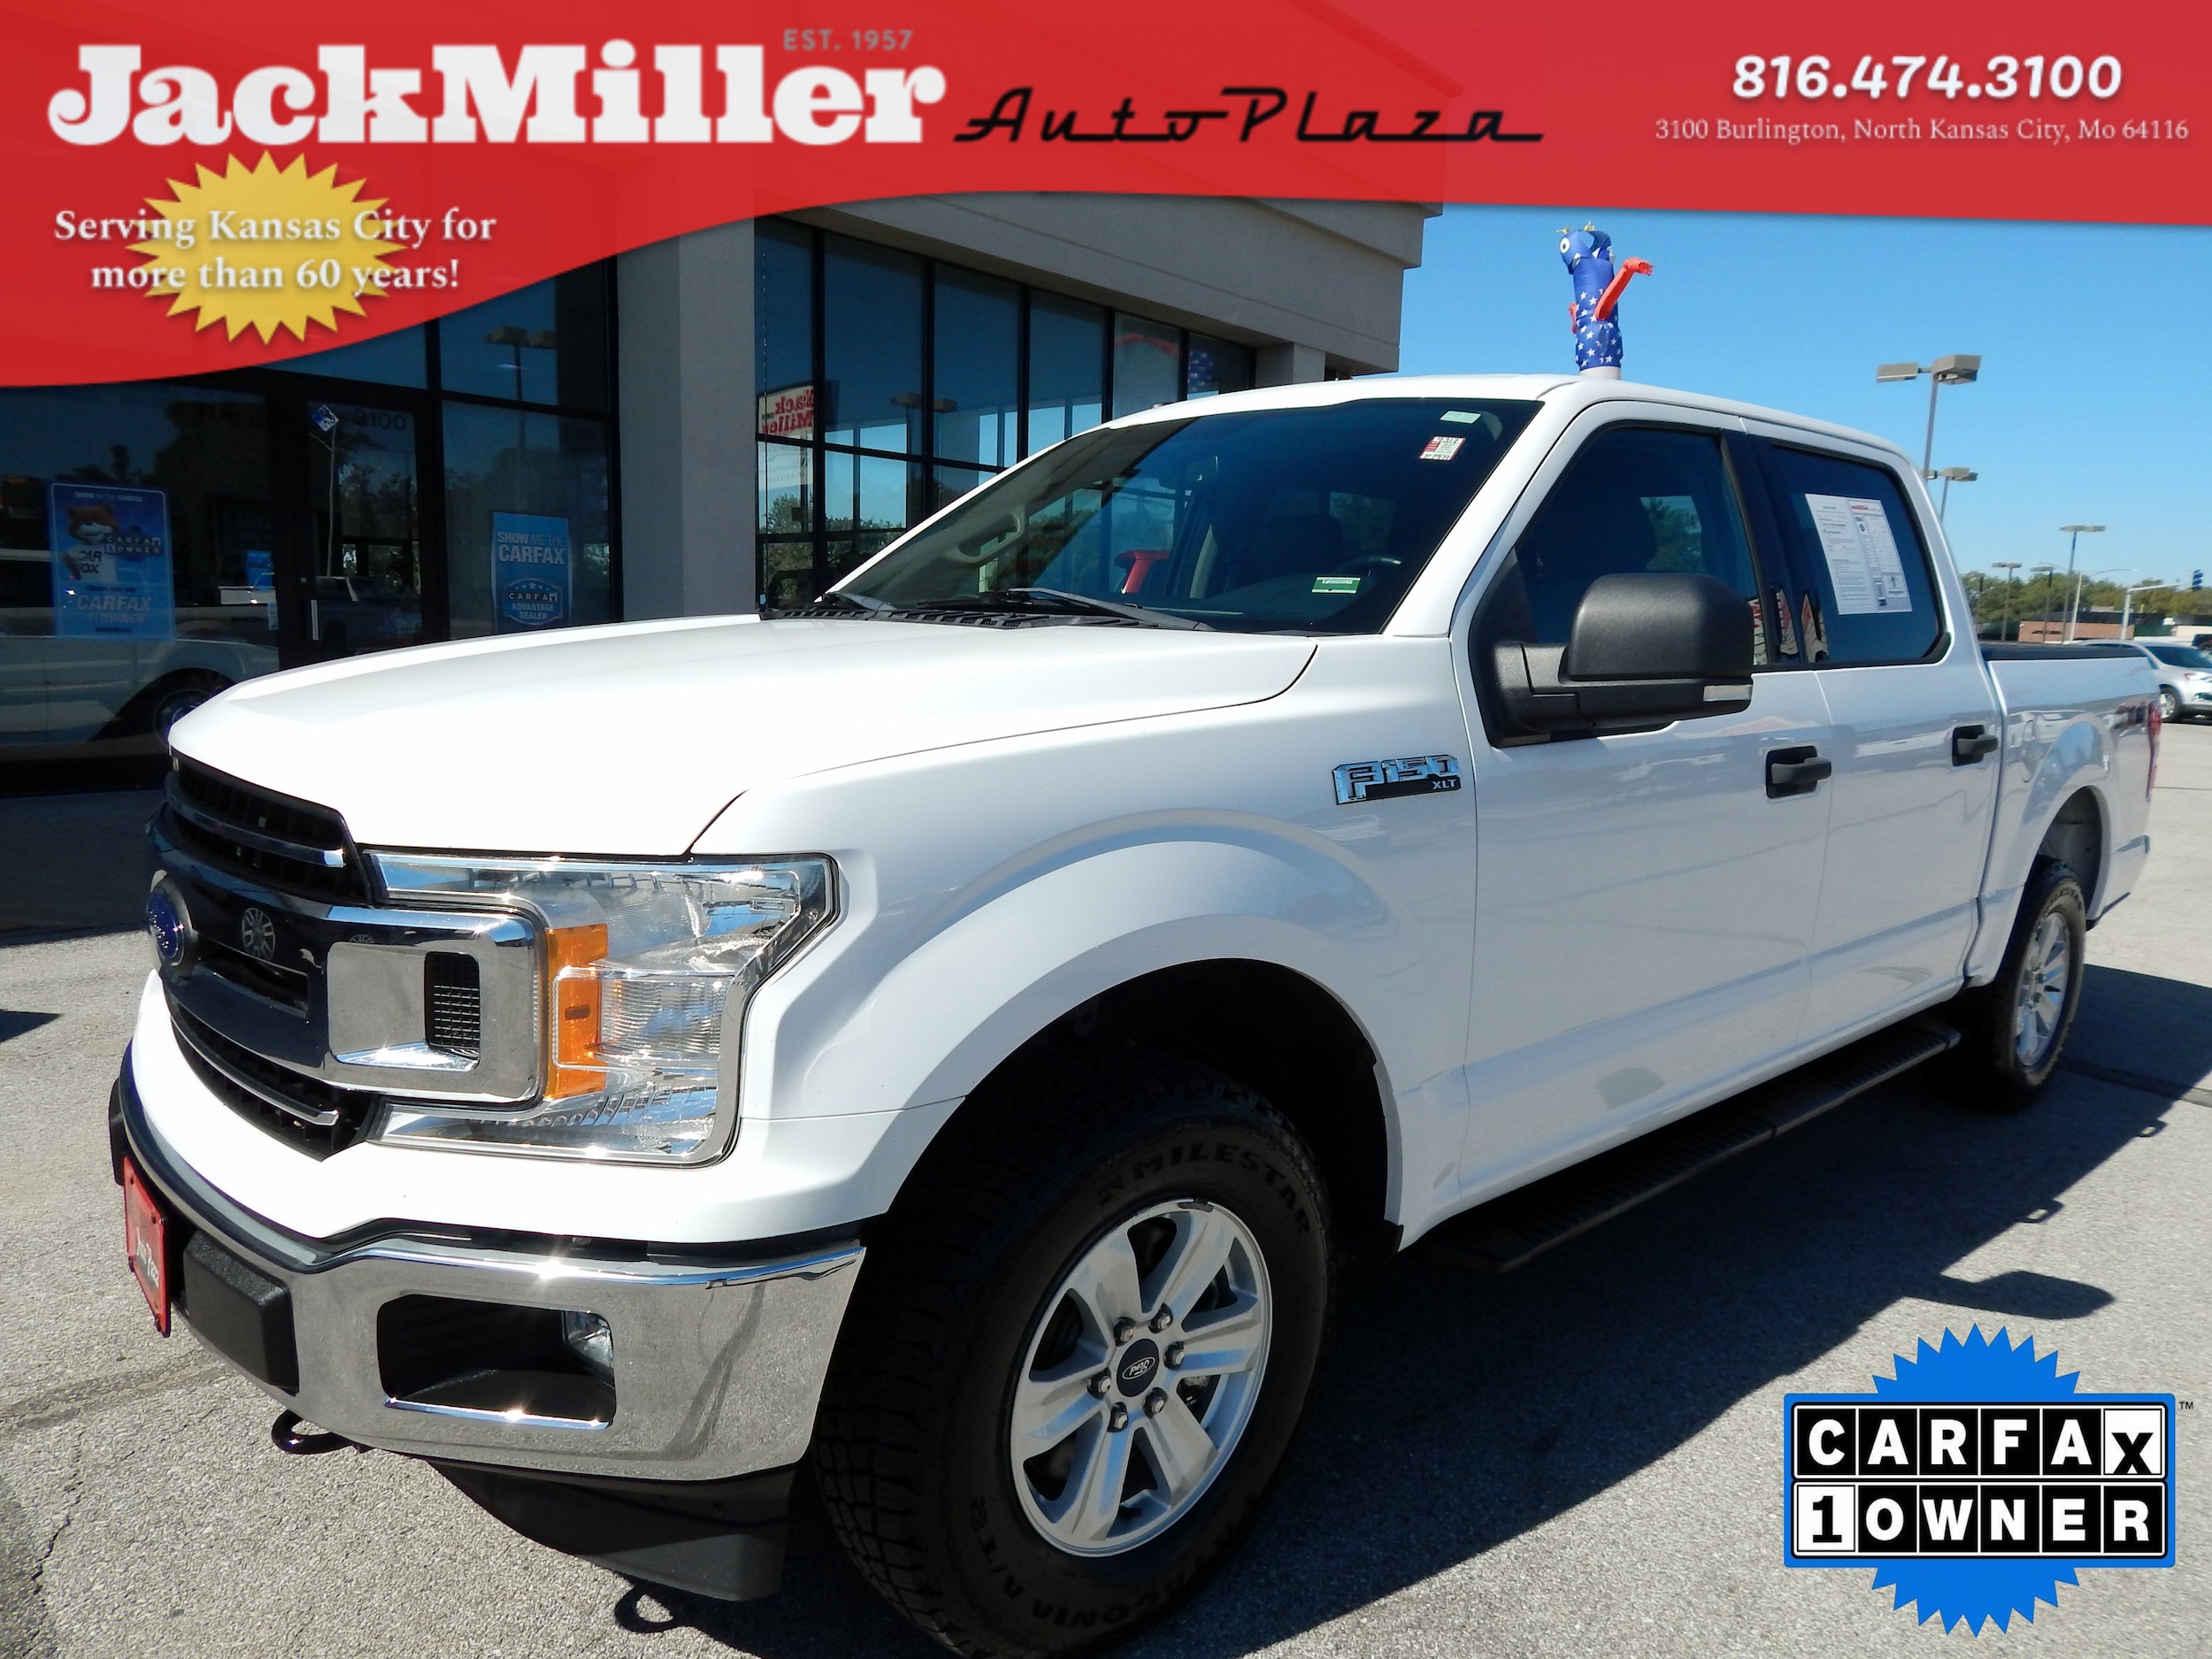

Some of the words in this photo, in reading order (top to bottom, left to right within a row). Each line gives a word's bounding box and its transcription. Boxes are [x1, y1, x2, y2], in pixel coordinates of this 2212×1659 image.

[498, 532, 529, 544] SHOW
[498, 544, 565, 565] CARFAX
[509, 591, 558, 602] CARFAX
[78, 595, 151, 611] CARFAX
[511, 603, 555, 611] ADVANTAGE
[519, 611, 548, 619] DEALER
[1432, 779, 1457, 790] XLT
[1133, 1142, 1310, 1233] MILESTAR
